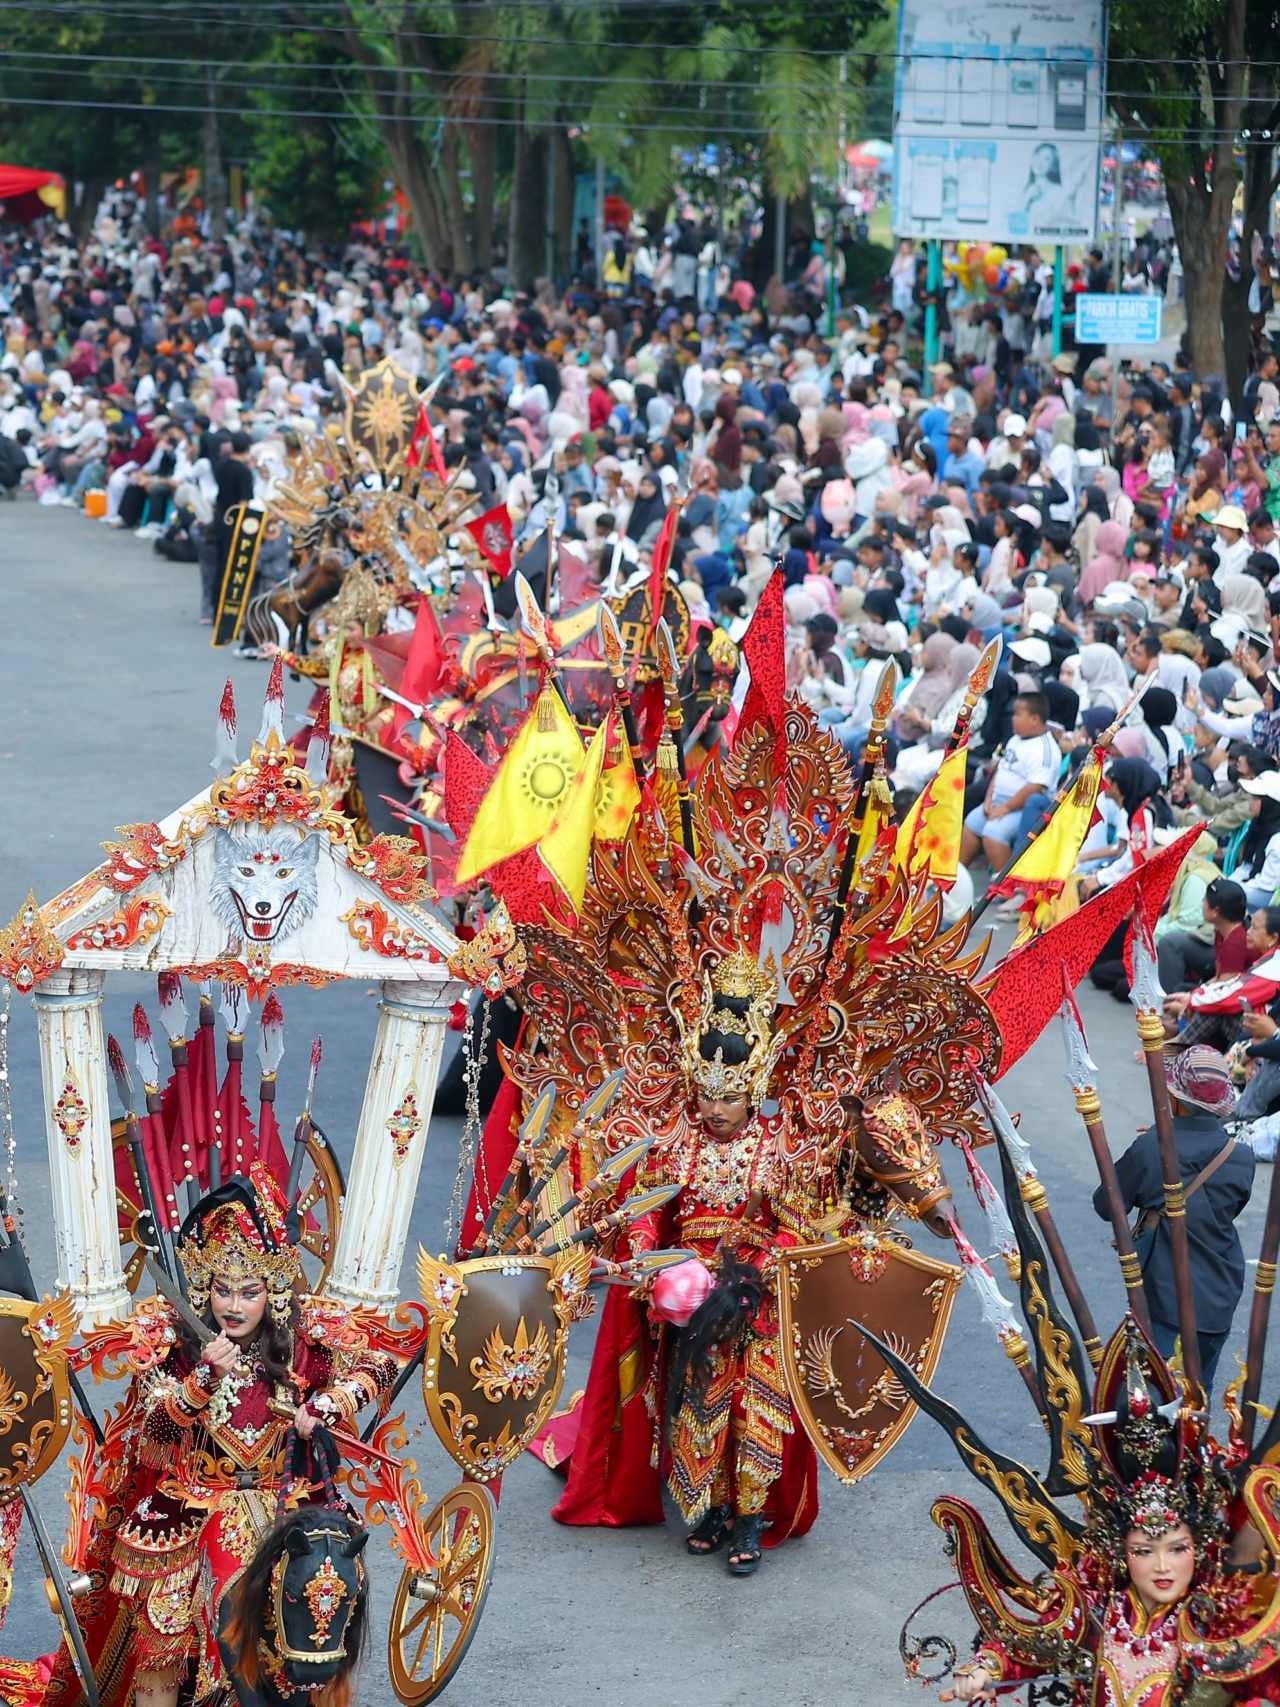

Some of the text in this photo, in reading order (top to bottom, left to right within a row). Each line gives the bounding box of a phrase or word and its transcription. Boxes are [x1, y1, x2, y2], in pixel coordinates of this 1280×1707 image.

[1086, 301, 1148, 319] PARKIR GRATIS
[232, 538, 252, 600] PPNI
